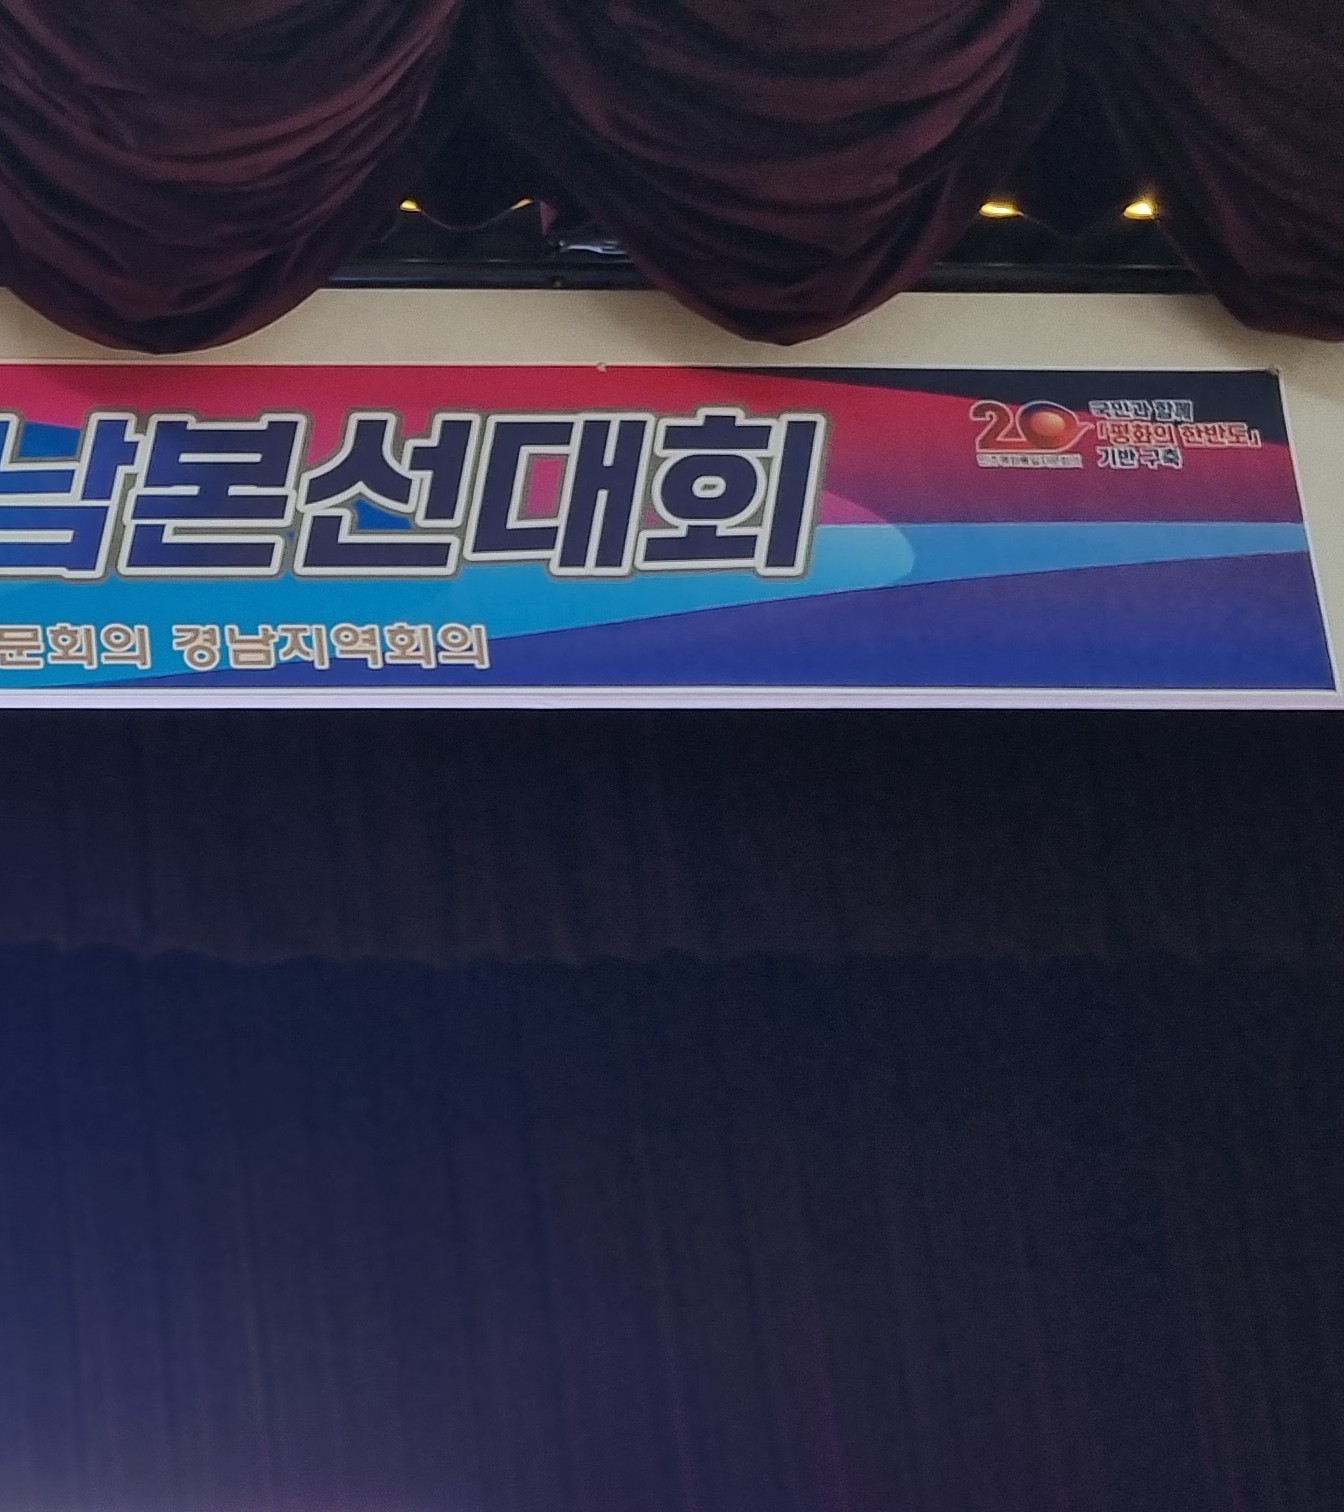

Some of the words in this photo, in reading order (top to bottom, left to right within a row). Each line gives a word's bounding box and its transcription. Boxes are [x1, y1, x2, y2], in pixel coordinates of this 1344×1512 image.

[1097, 447, 1138, 467] 기반
[1140, 447, 1183, 469] 구축
[172, 622, 490, 673] 경남지역회의
